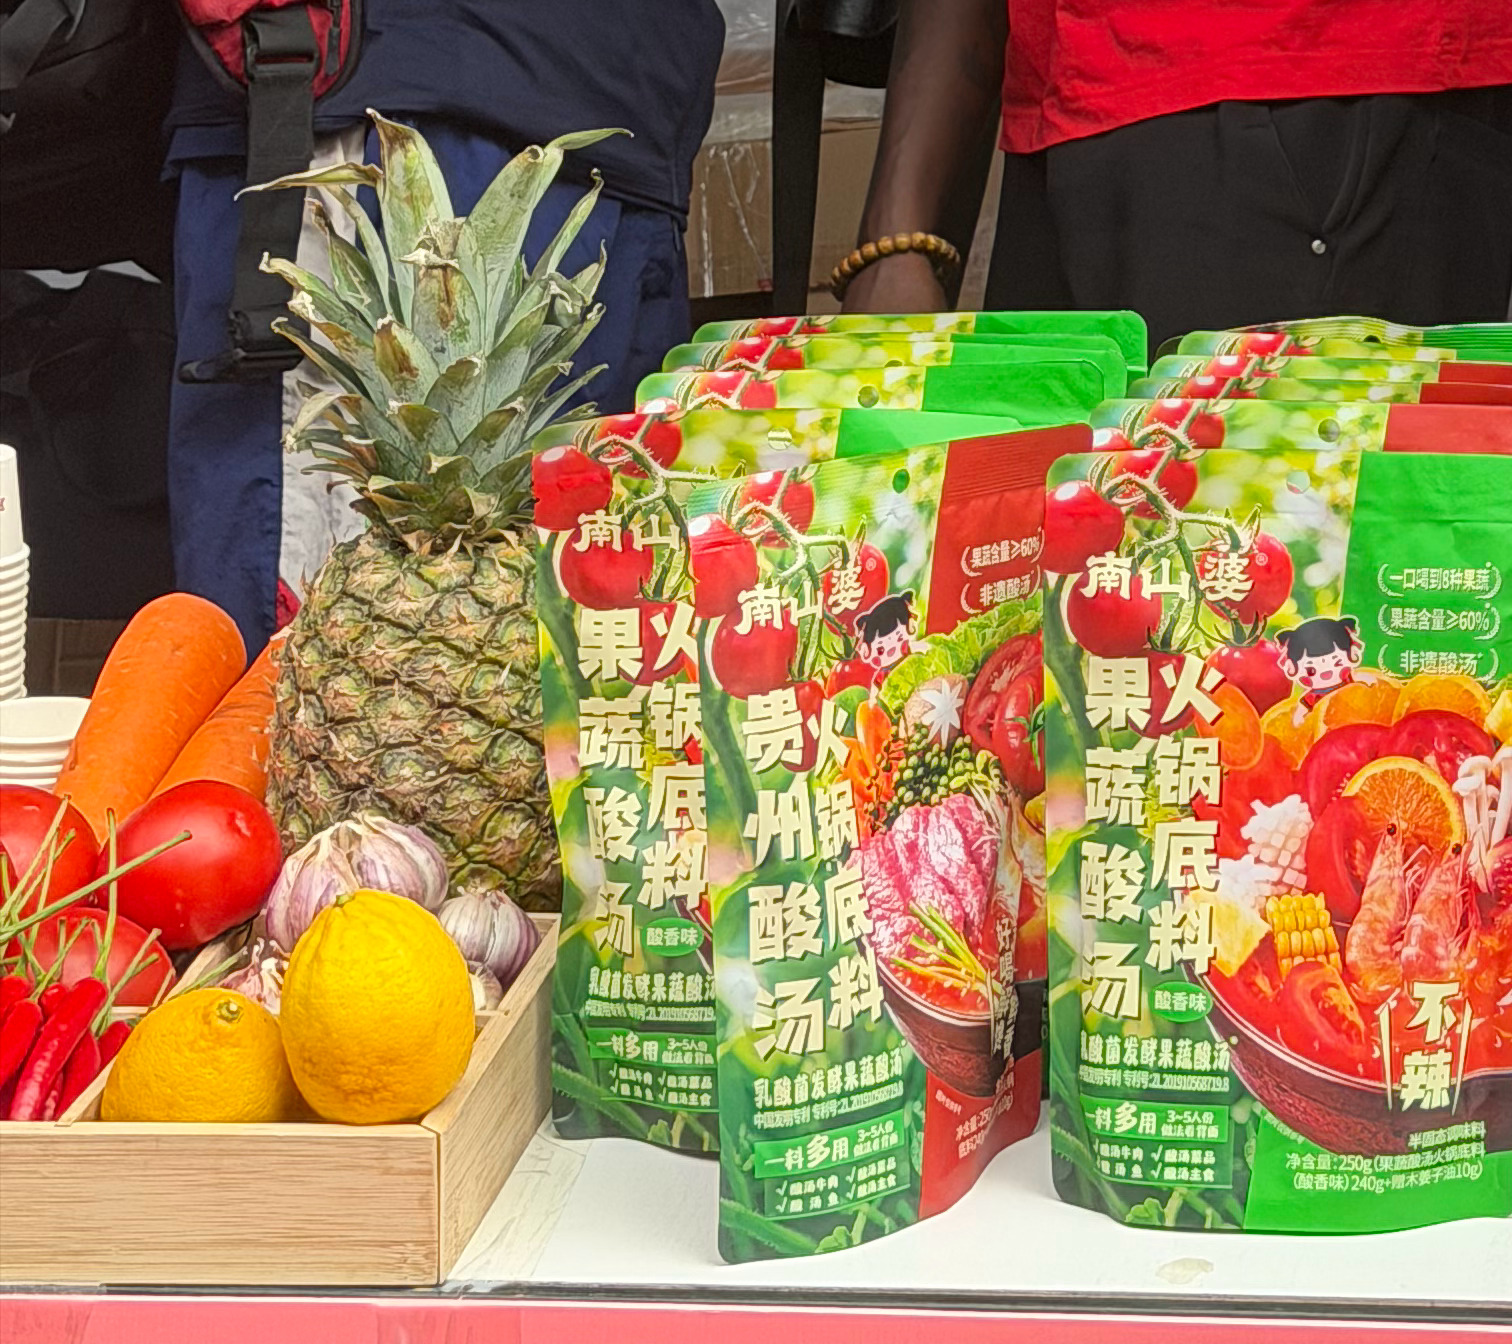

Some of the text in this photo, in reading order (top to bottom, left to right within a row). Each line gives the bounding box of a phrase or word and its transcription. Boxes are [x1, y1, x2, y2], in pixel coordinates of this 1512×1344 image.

[734, 554, 867, 636] 南山婆
[979, 574, 1031, 607] 非遗酸汤
[1081, 550, 1255, 603] 南山婆
[1389, 567, 1491, 592] 一口喝到8种果蔬
[1390, 607, 1490, 632] 果蔬含量≥60%
[1400, 649, 1478, 676] 非遗酸汤
[638, 601, 709, 911] 火锅底料
[1079, 656, 1153, 1020] 果蔬酸汤
[1144, 656, 1227, 976] 火锅底料
[743, 686, 827, 1062] 贵州酸汤
[808, 698, 886, 1025] 火锅底料
[646, 926, 699, 947] 酸香味
[1154, 990, 1207, 1012] 酸香味
[1399, 980, 1461, 1112] 不辣
[1085, 1101, 1157, 1135] 一料多用
[764, 1134, 850, 1172] 一料多用
